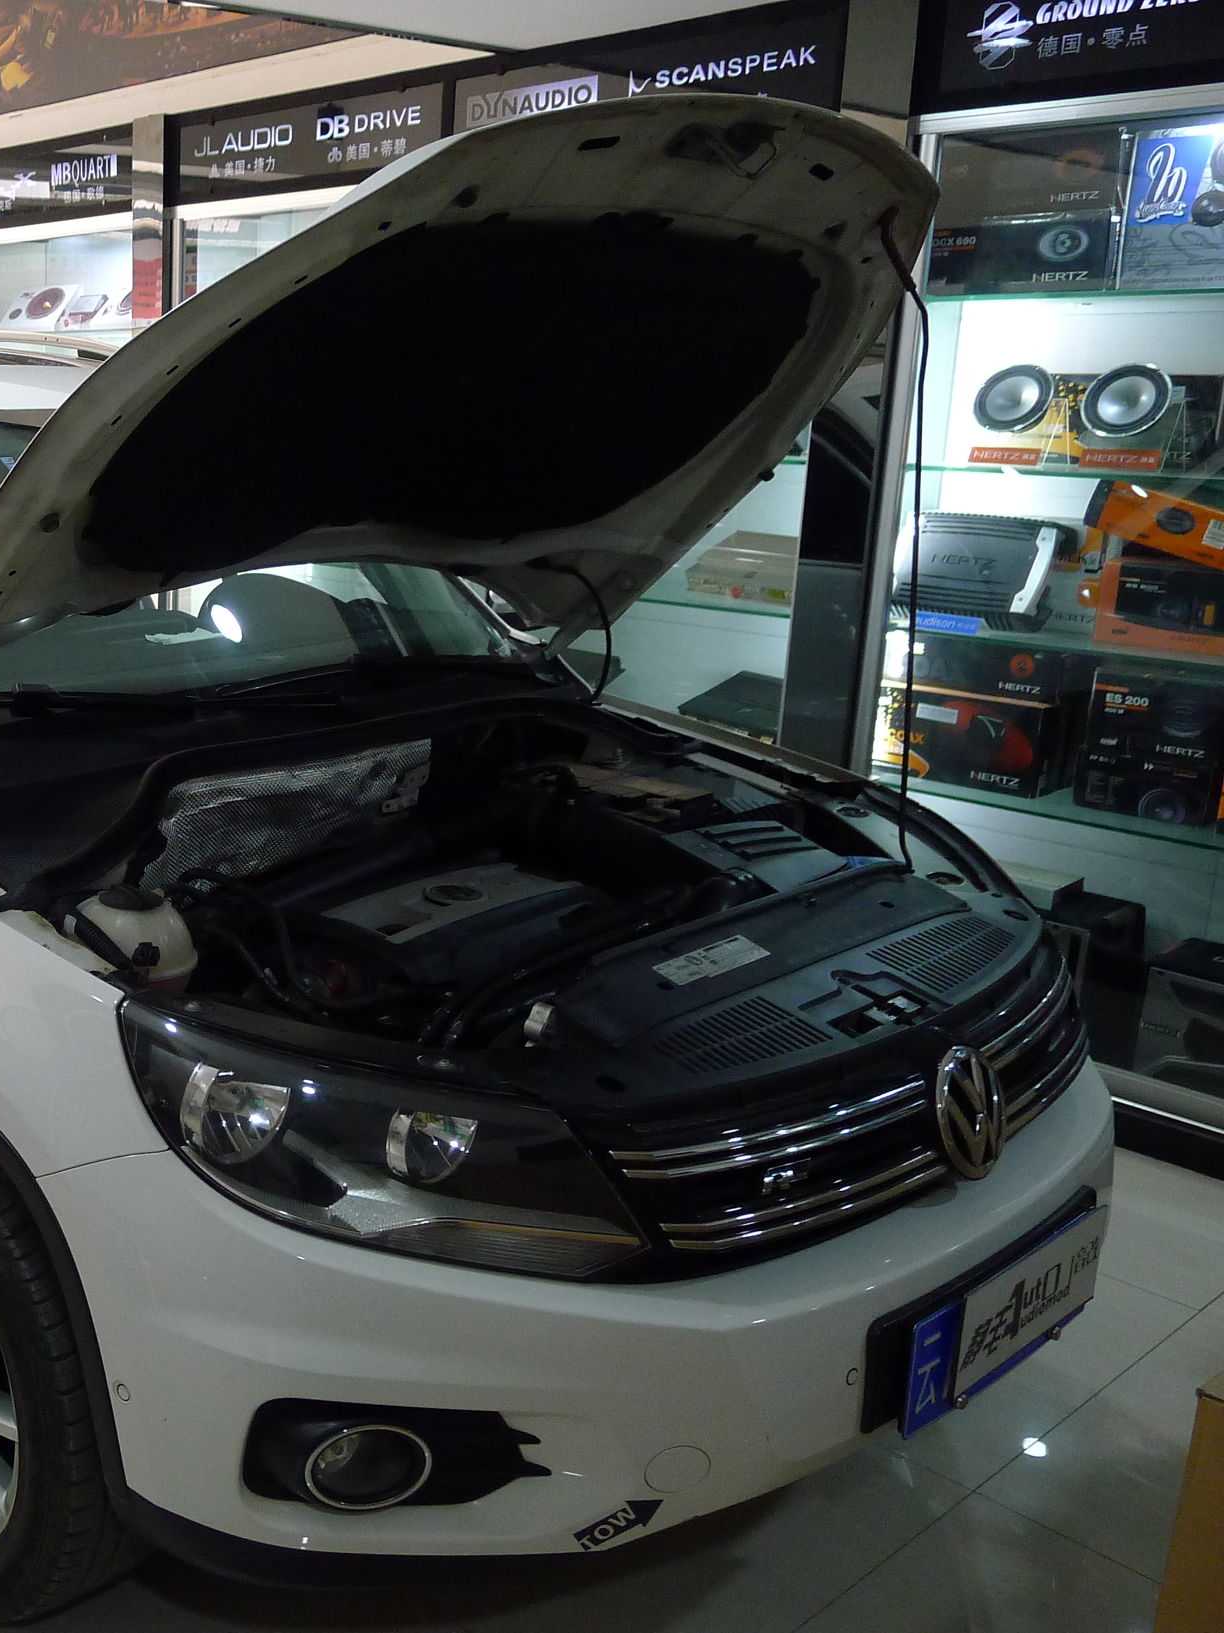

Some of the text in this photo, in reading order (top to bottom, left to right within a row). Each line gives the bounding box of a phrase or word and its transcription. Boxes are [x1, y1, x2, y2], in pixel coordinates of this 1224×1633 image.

[1036, 0, 1131, 24] GROUND
[1037, 24, 1149, 60] 德国·零点
[654, 44, 817, 90] SCANSPEAK
[470, 82, 594, 122] DYNAUDIO
[315, 105, 422, 142] DB DRIVE
[194, 123, 293, 156] JL AUDIO
[1050, 190, 1099, 202] HERTZ
[1032, 271, 1089, 283] HERTZ
[973, 451, 1021, 461] HERTZ
[1085, 454, 1138, 464] HERTZ
[931, 553, 999, 572] HERTZ
[998, 680, 1042, 694] HERTZ
[1105, 692, 1149, 707] ES 200
[1154, 743, 1206, 759] HERTZ
[969, 770, 1021, 786] HERTZ
[578, 1504, 638, 1550] TOW
